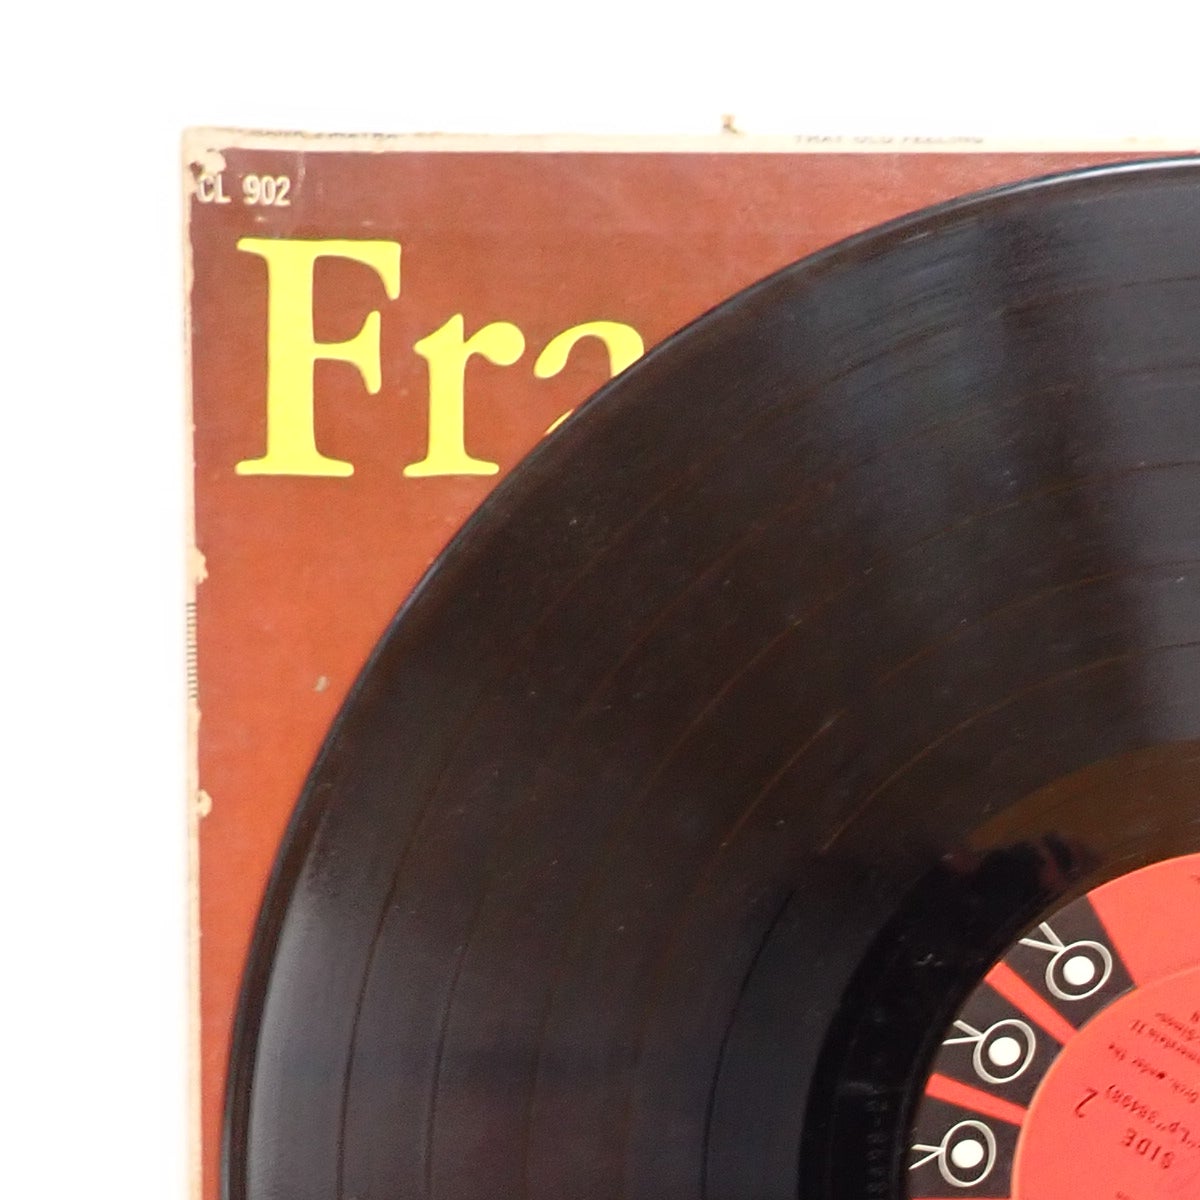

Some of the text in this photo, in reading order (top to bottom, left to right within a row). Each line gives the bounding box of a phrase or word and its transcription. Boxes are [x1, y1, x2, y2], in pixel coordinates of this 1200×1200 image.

[197, 173, 291, 206] CL 902
[1072, 1086, 1177, 1171] SIDE 2
